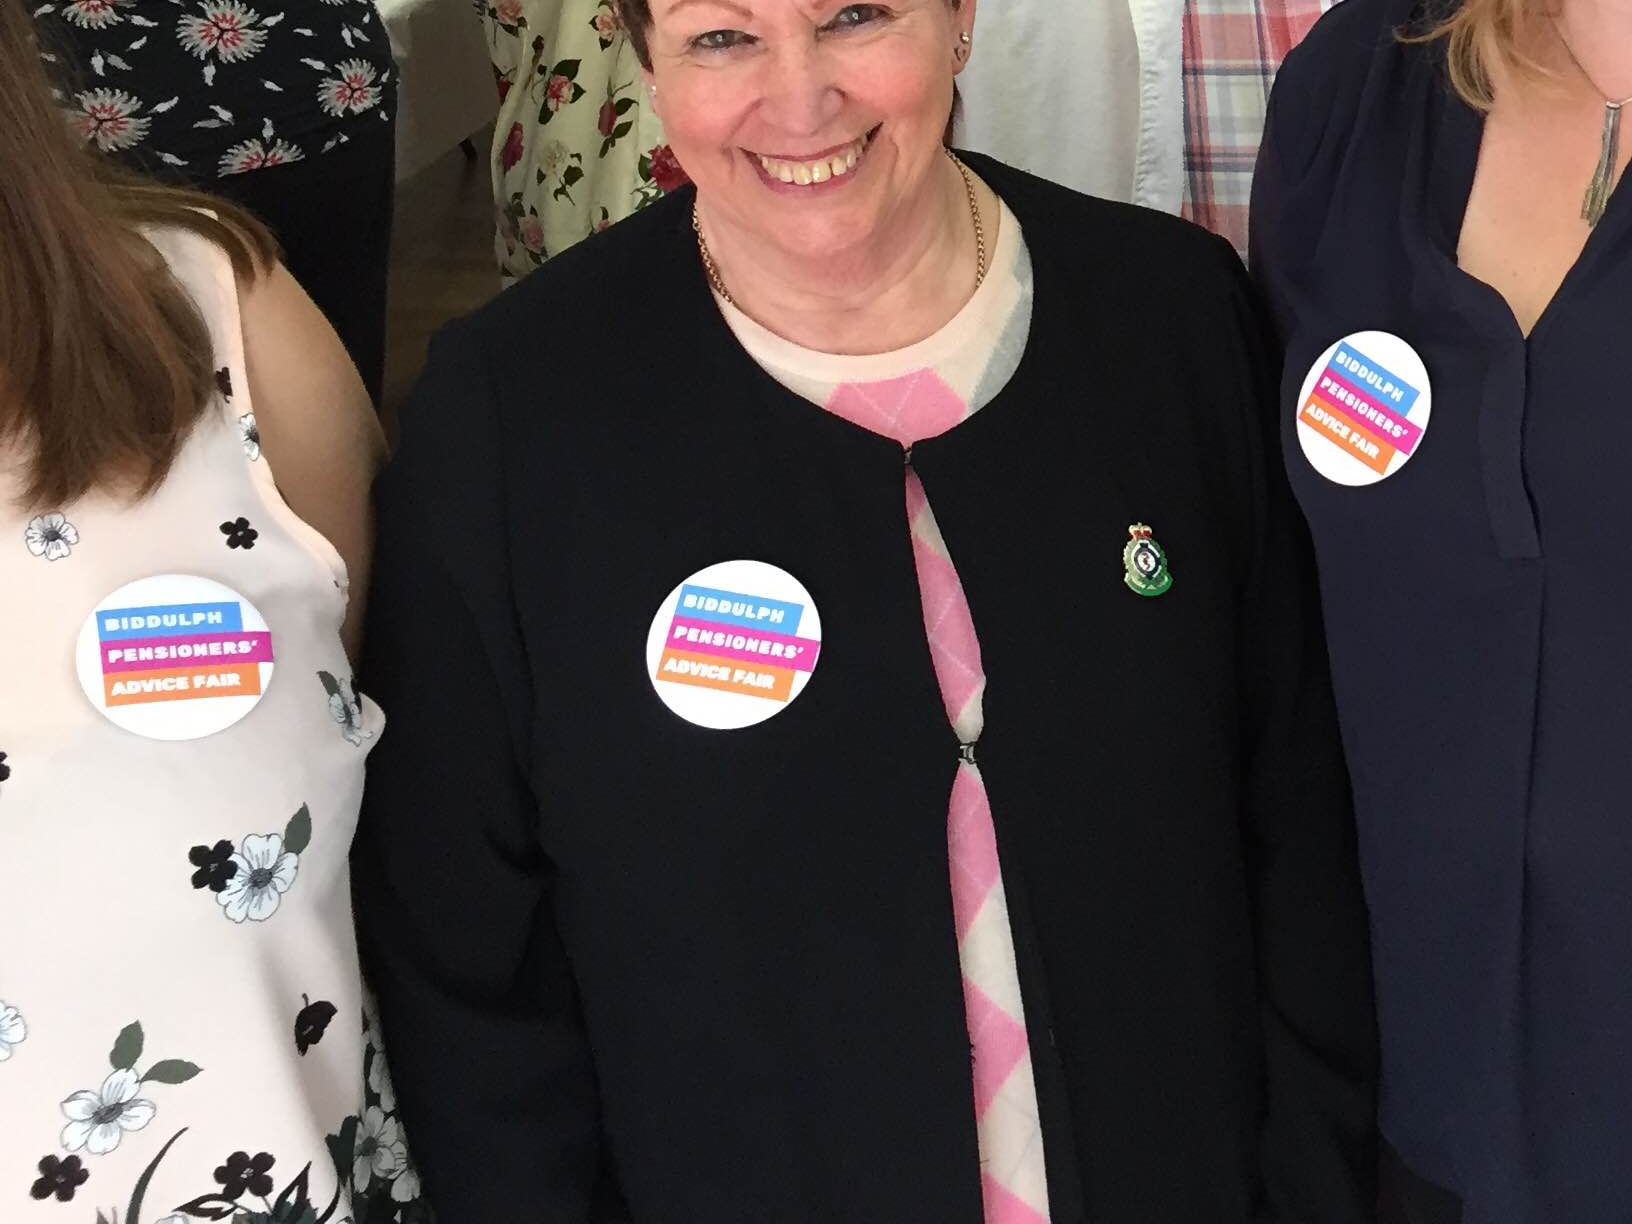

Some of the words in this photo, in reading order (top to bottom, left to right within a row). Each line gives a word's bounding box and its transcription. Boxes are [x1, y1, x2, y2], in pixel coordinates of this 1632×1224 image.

[1335, 351, 1405, 403] BIDDULPH
[1320, 376, 1409, 438] PENSIONERS'
[1305, 403, 1351, 440] ADVICE
[1348, 431, 1380, 459] FAIR
[104, 611, 223, 632] BIDDULPH
[683, 594, 785, 624] BIDDULPH
[108, 639, 258, 664] PENSIONERS'
[673, 625, 804, 659] PENSIONERS'
[111, 676, 190, 697] ADVICE
[193, 673, 241, 689] FAIR
[663, 657, 731, 681] ADVICE
[732, 668, 776, 690] FAIR
